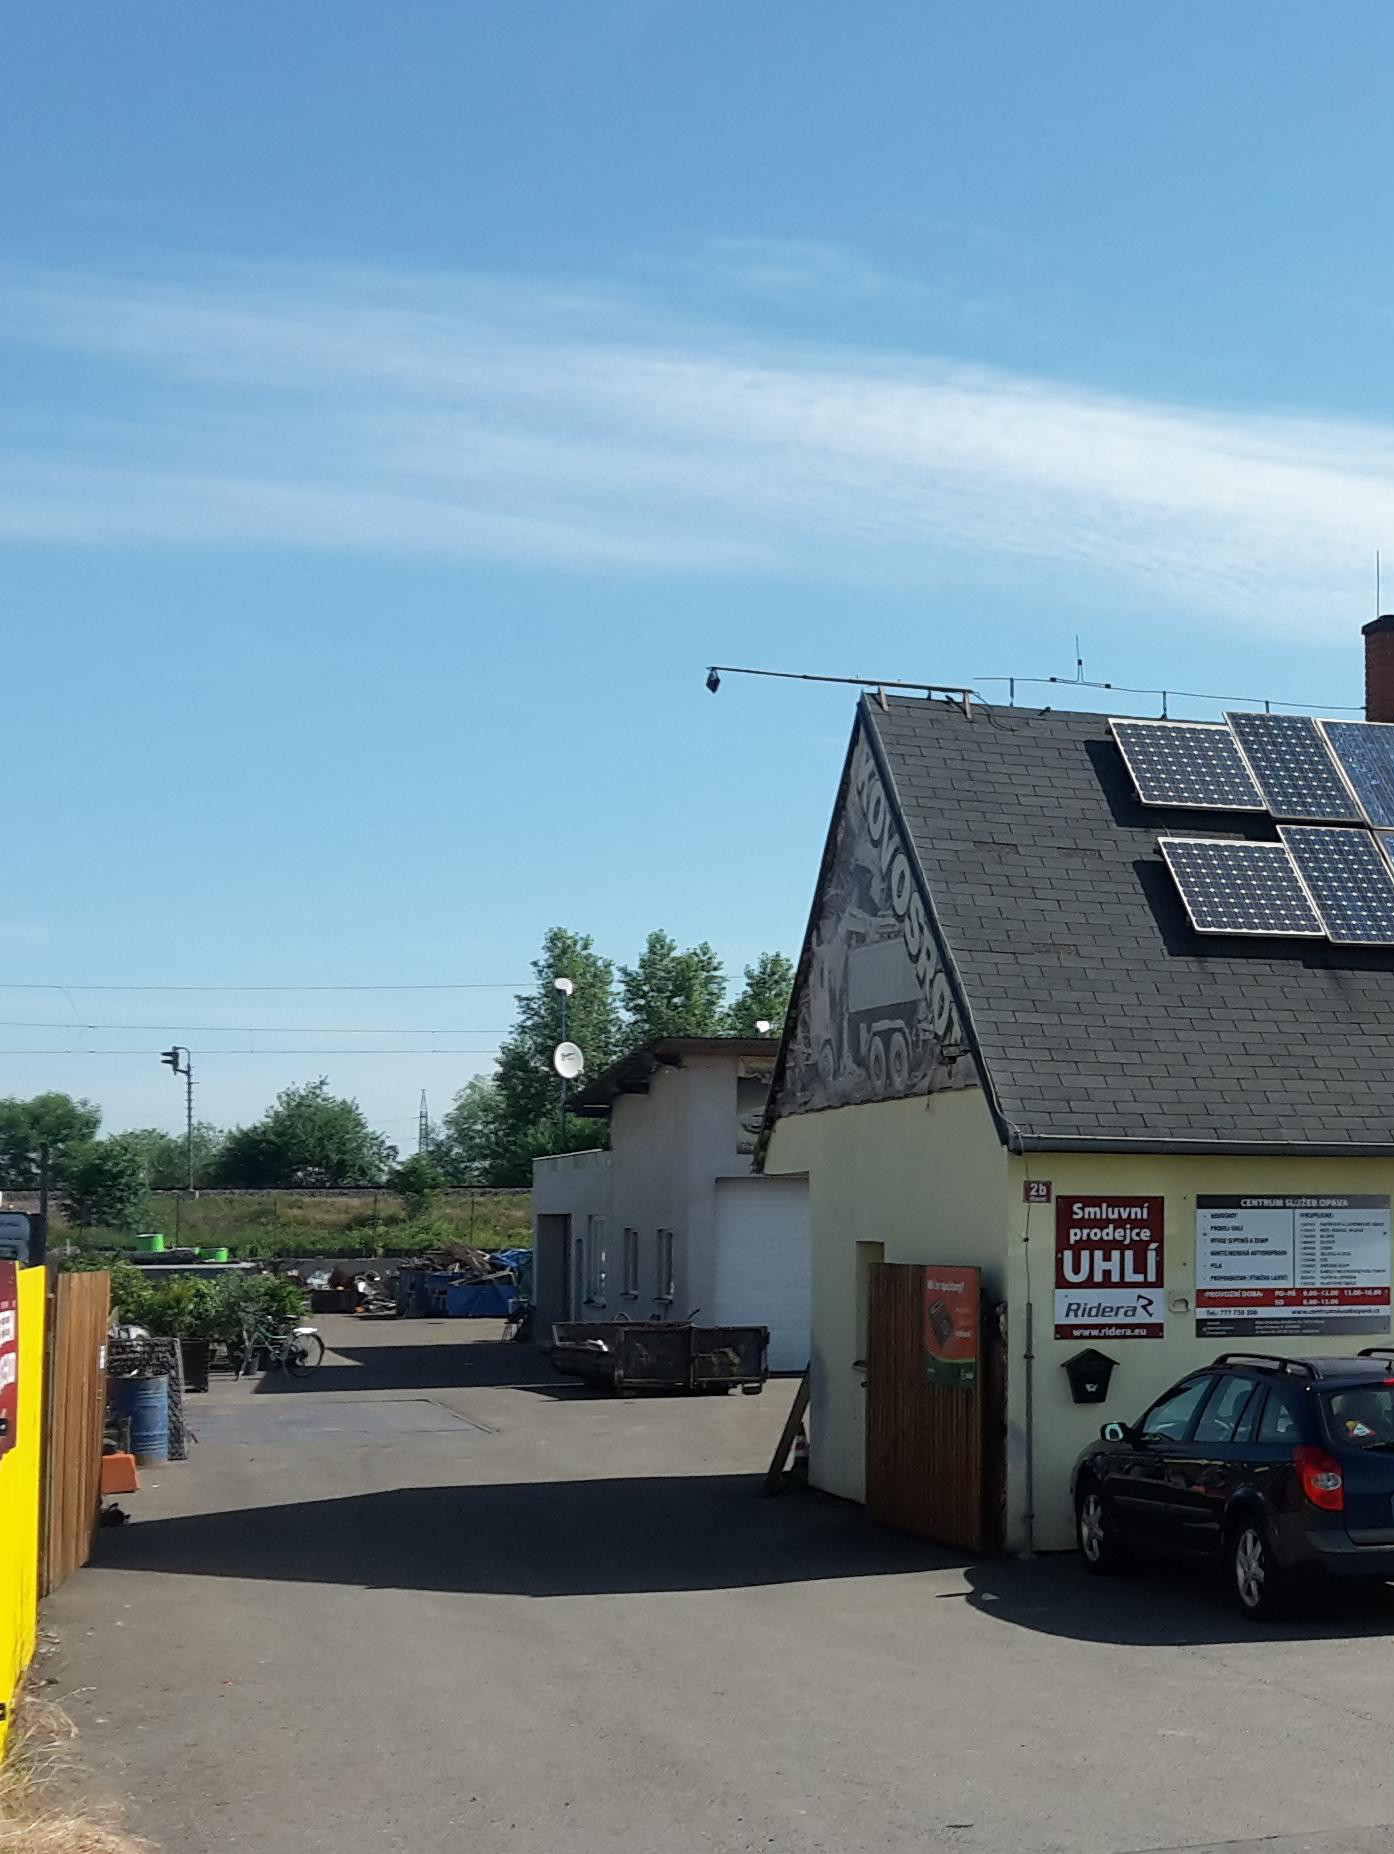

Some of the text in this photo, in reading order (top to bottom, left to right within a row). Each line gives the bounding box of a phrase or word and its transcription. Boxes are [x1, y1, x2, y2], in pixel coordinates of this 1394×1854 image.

[1029, 1183, 1047, 1196] 2b
[1072, 1203, 1149, 1220] Smluvní
[1069, 1224, 1151, 1244] prodejce
[1063, 1243, 1160, 1283] UHLÍ
[1064, 1302, 1137, 1318] Ridera
[1072, 1327, 1147, 1337] www.ridera.eu
